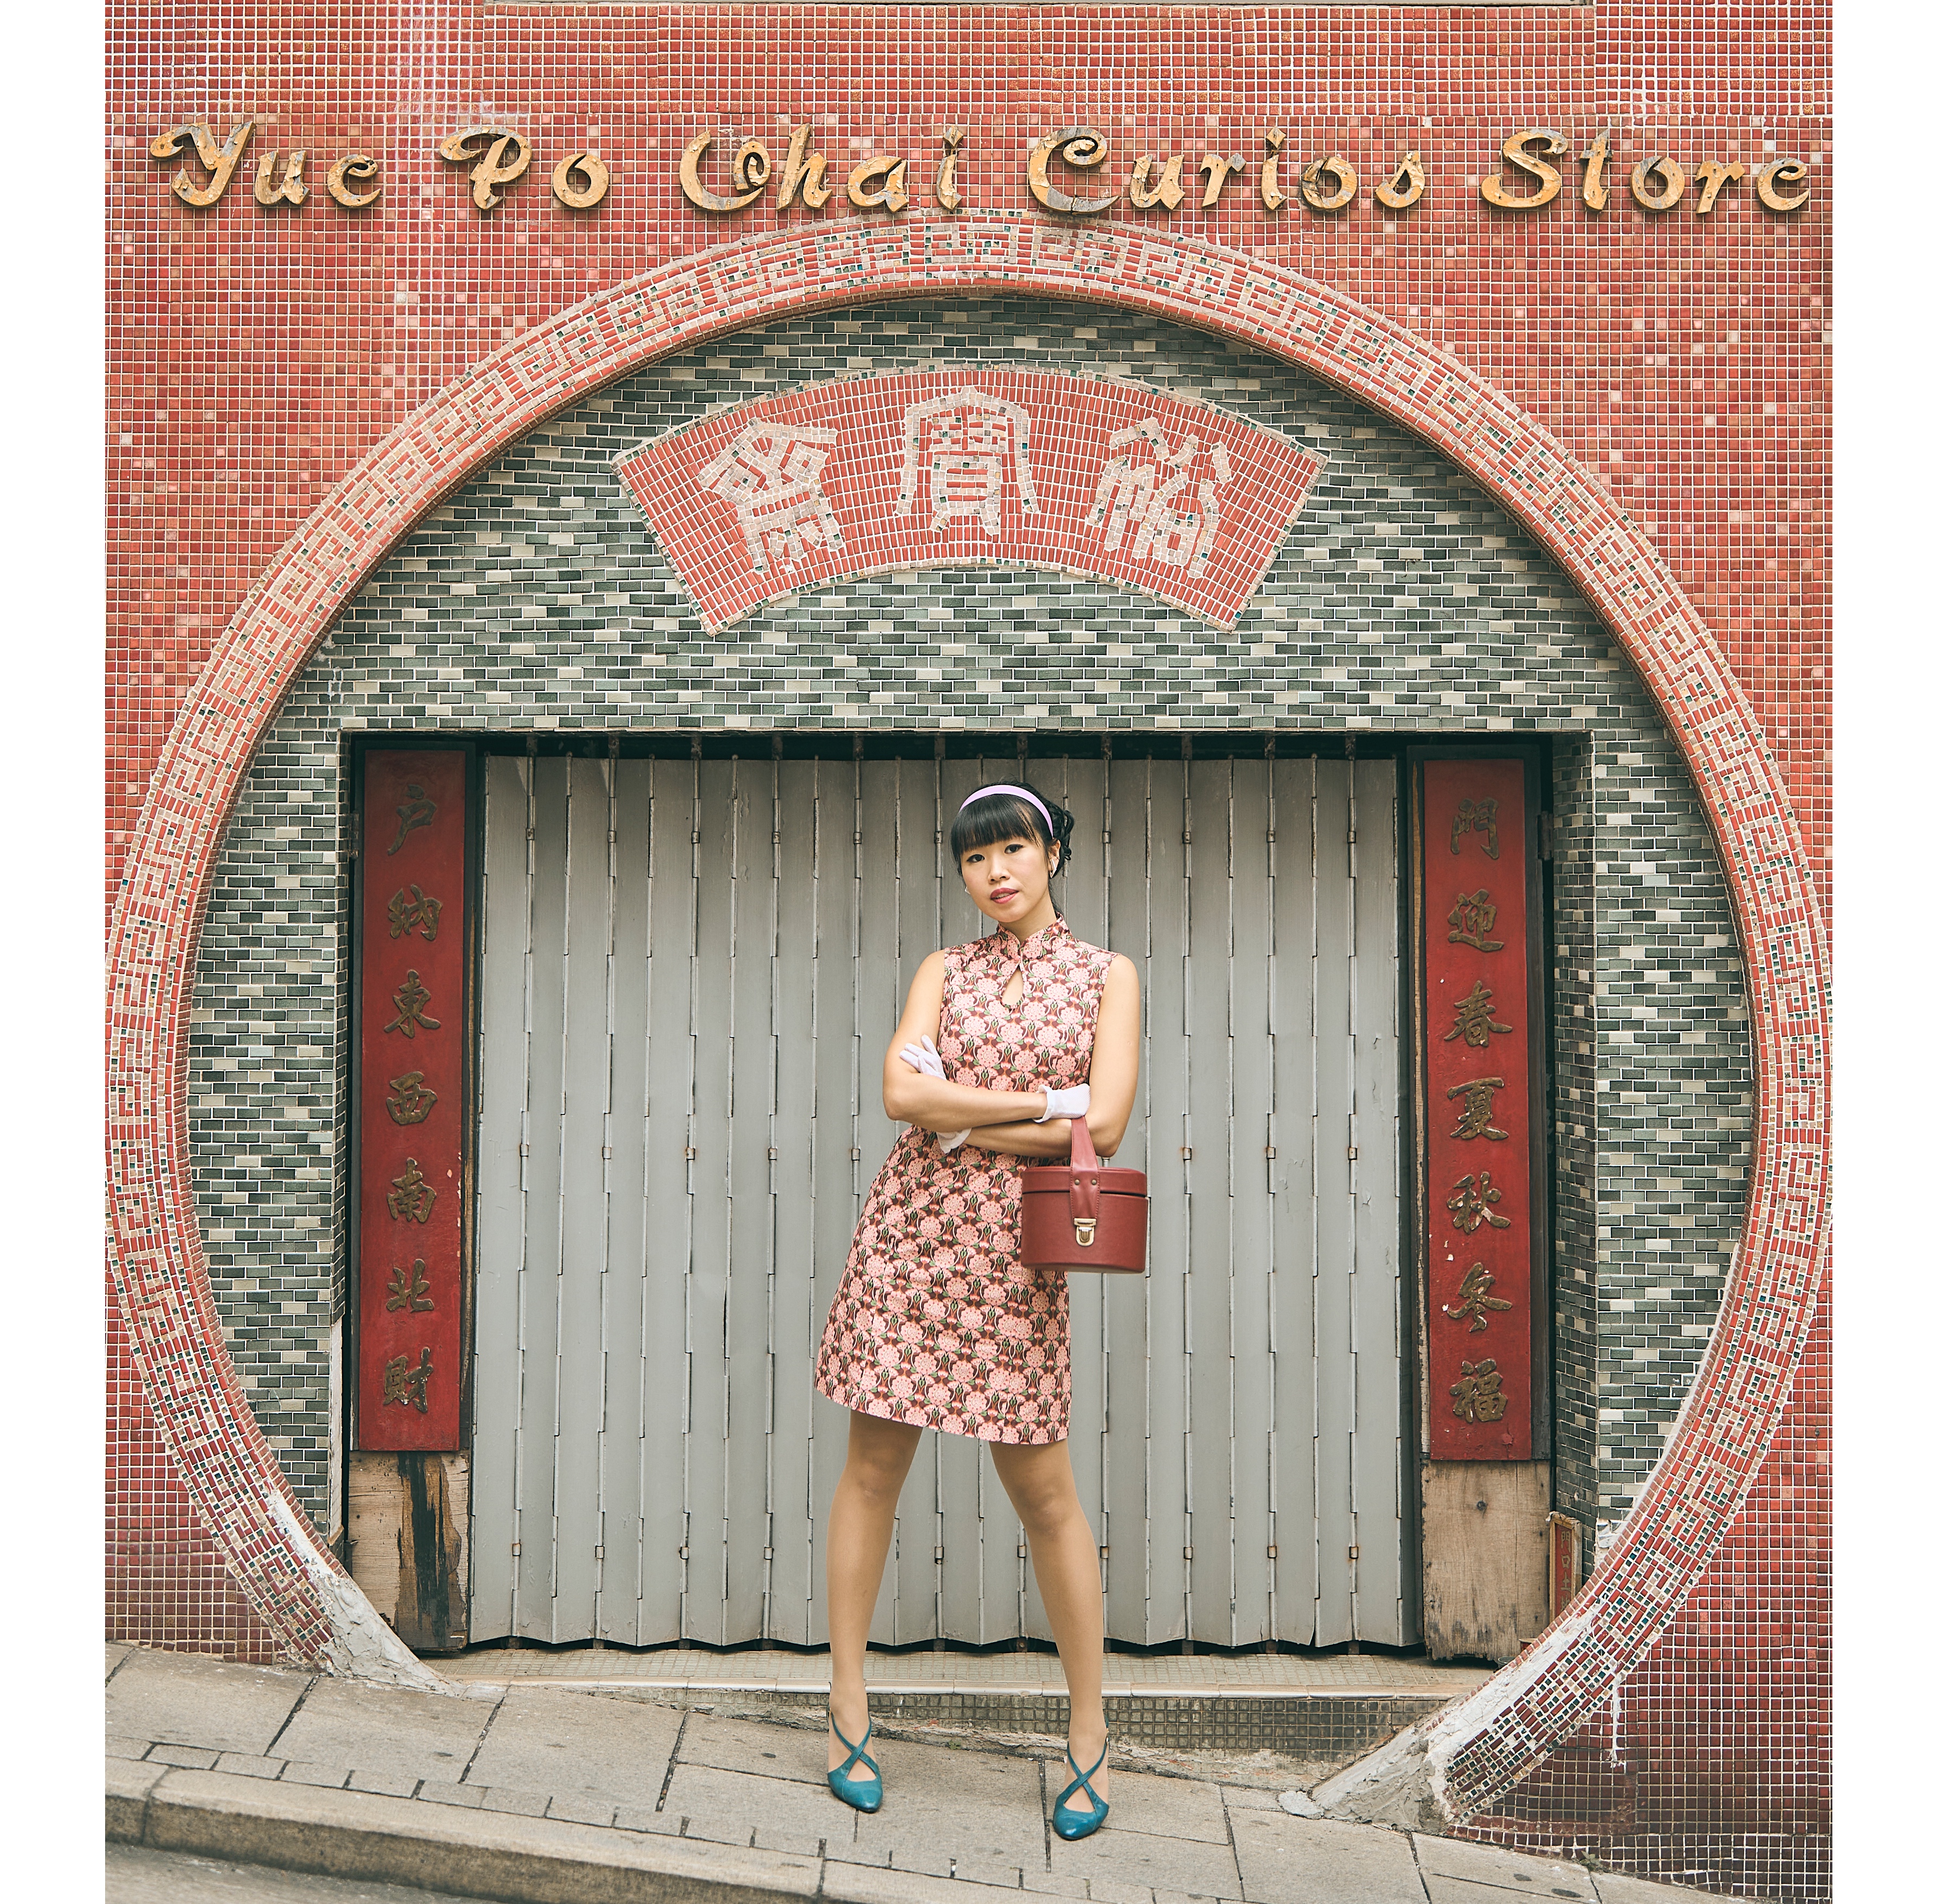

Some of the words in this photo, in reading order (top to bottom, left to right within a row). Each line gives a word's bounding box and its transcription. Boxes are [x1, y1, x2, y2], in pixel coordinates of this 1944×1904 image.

[150, 120, 383, 208] Yue
[439, 125, 611, 210] Po
[679, 122, 964, 213] Chai
[1029, 125, 1425, 215] Curios
[1480, 128, 1811, 214] Store
